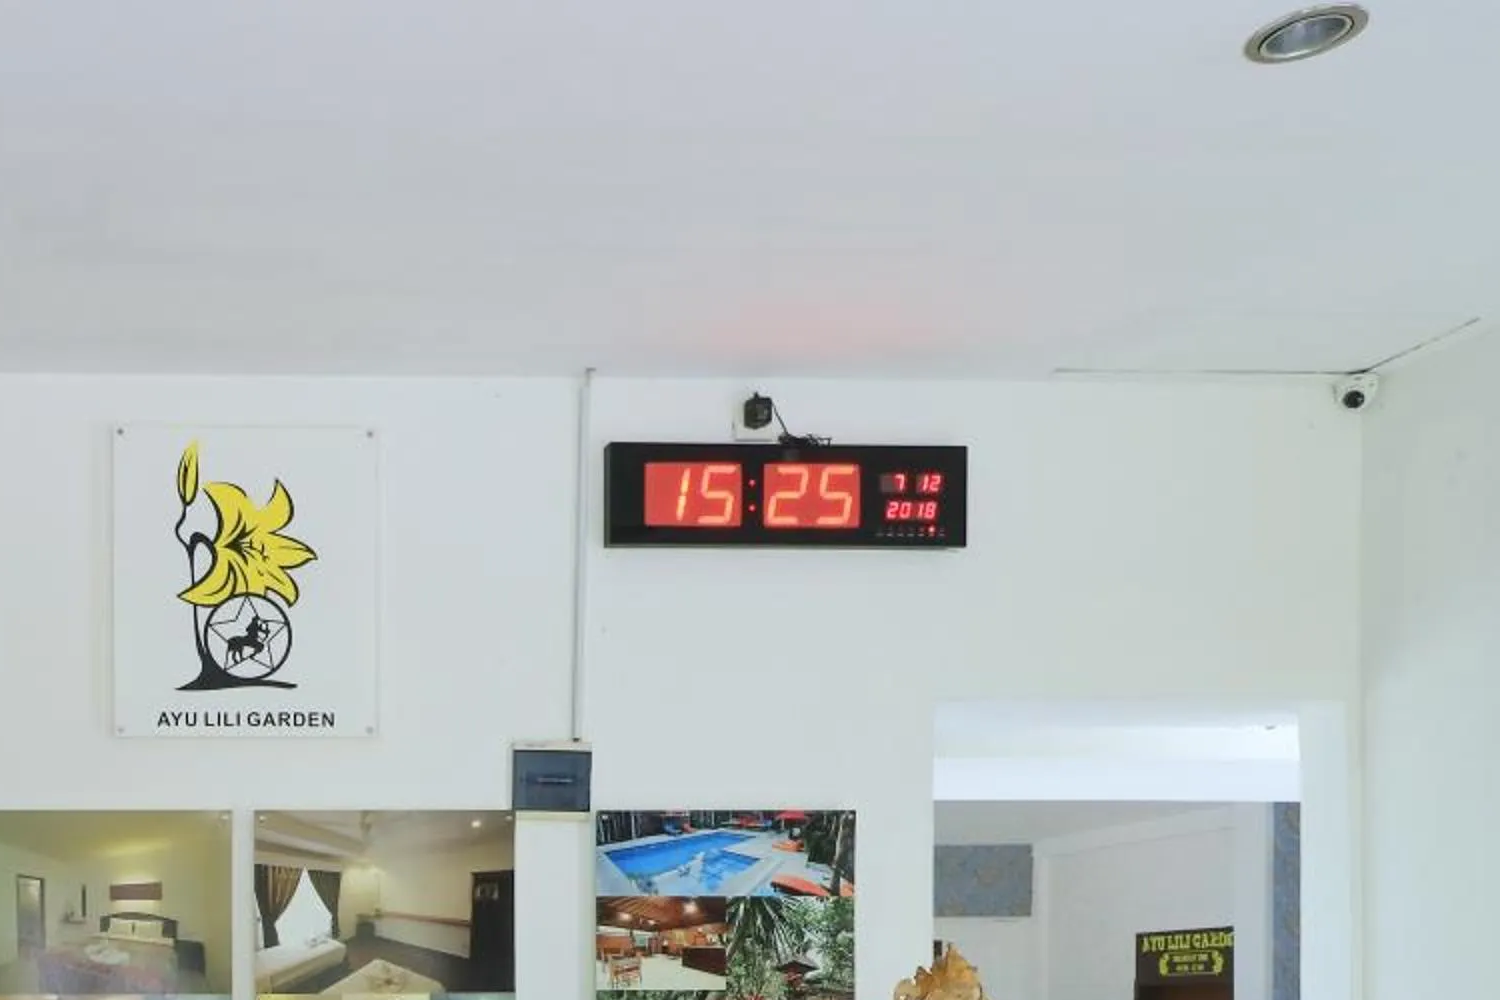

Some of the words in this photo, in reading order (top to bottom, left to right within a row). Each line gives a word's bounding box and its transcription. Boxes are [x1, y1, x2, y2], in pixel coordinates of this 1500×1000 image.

[892, 474, 905, 490] 7
[920, 474, 941, 491] 12
[675, 464, 857, 525] 15:25
[885, 501, 938, 520] 2018
[156, 710, 198, 728] AYU
[203, 710, 242, 728] LILI
[246, 710, 336, 728] GARDEN
